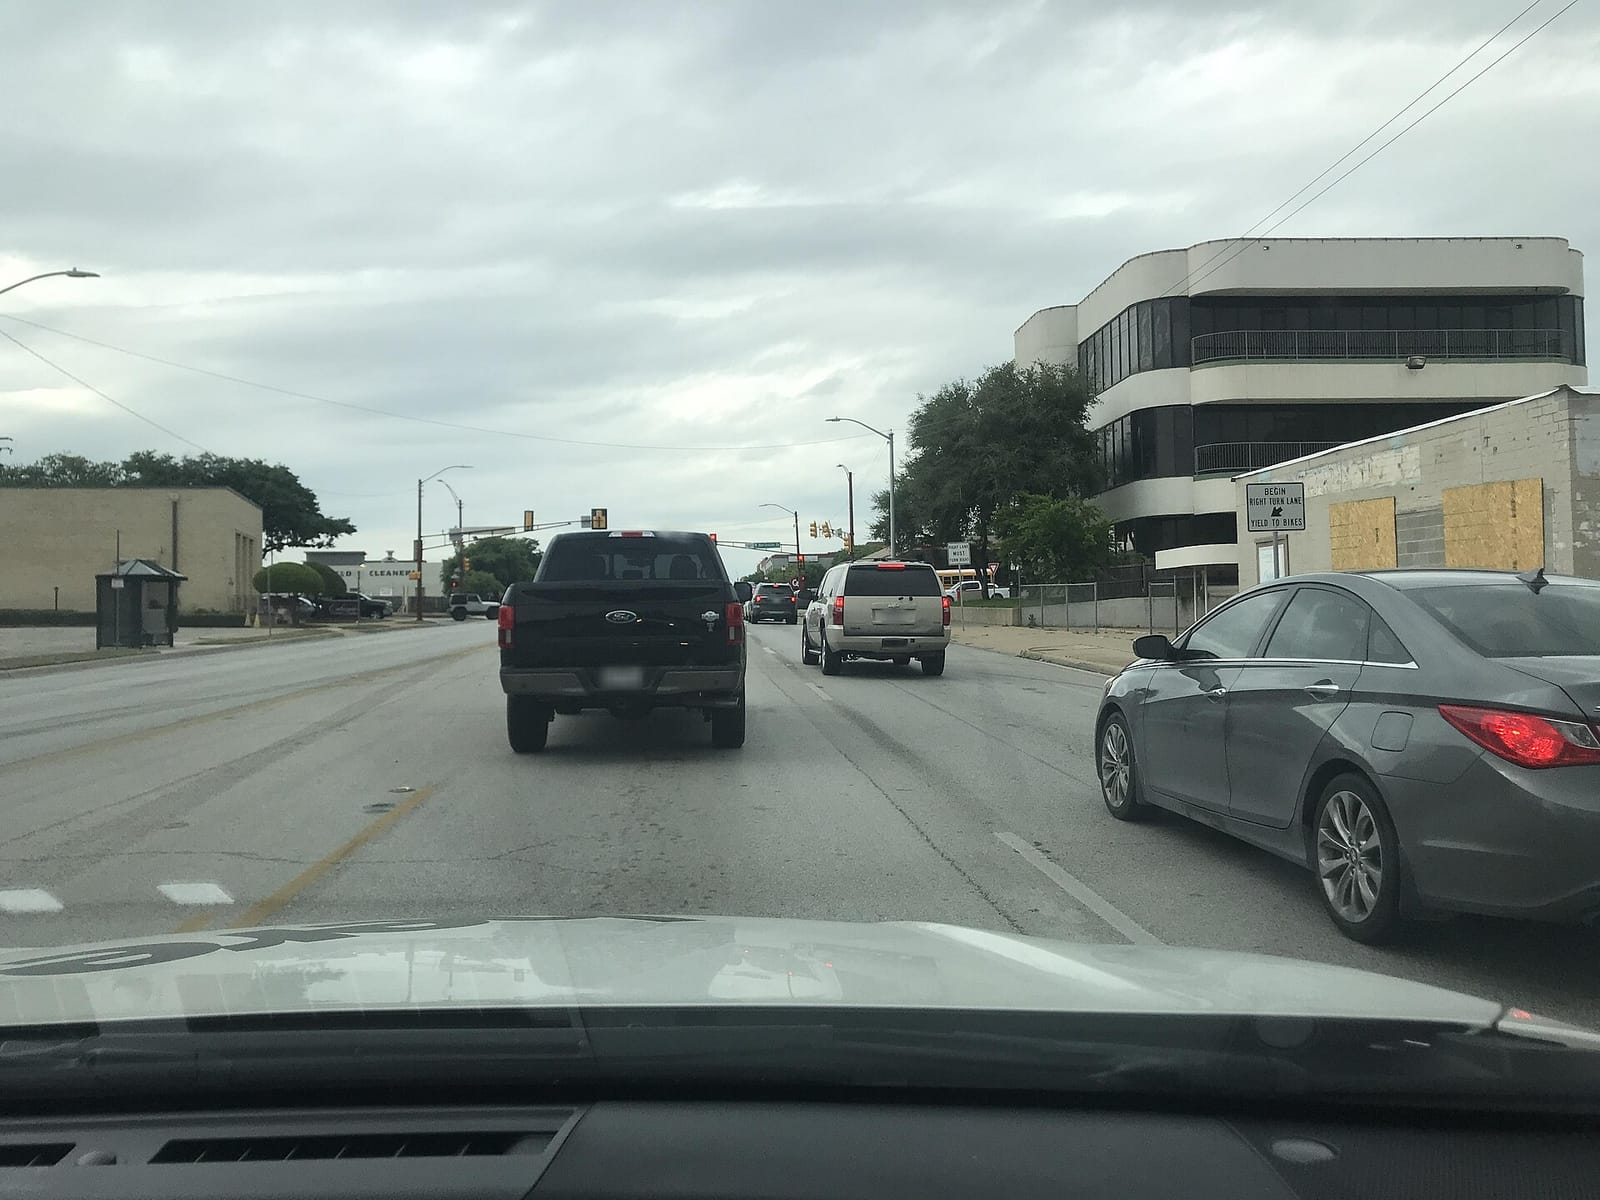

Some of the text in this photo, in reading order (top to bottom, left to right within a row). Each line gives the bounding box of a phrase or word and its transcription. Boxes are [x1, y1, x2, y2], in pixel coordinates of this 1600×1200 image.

[1264, 487, 1286, 496] BEGIN
[1249, 496, 1302, 506] RIGHT TURN LANE
[1250, 518, 1303, 528] YIELD TO BIKES
